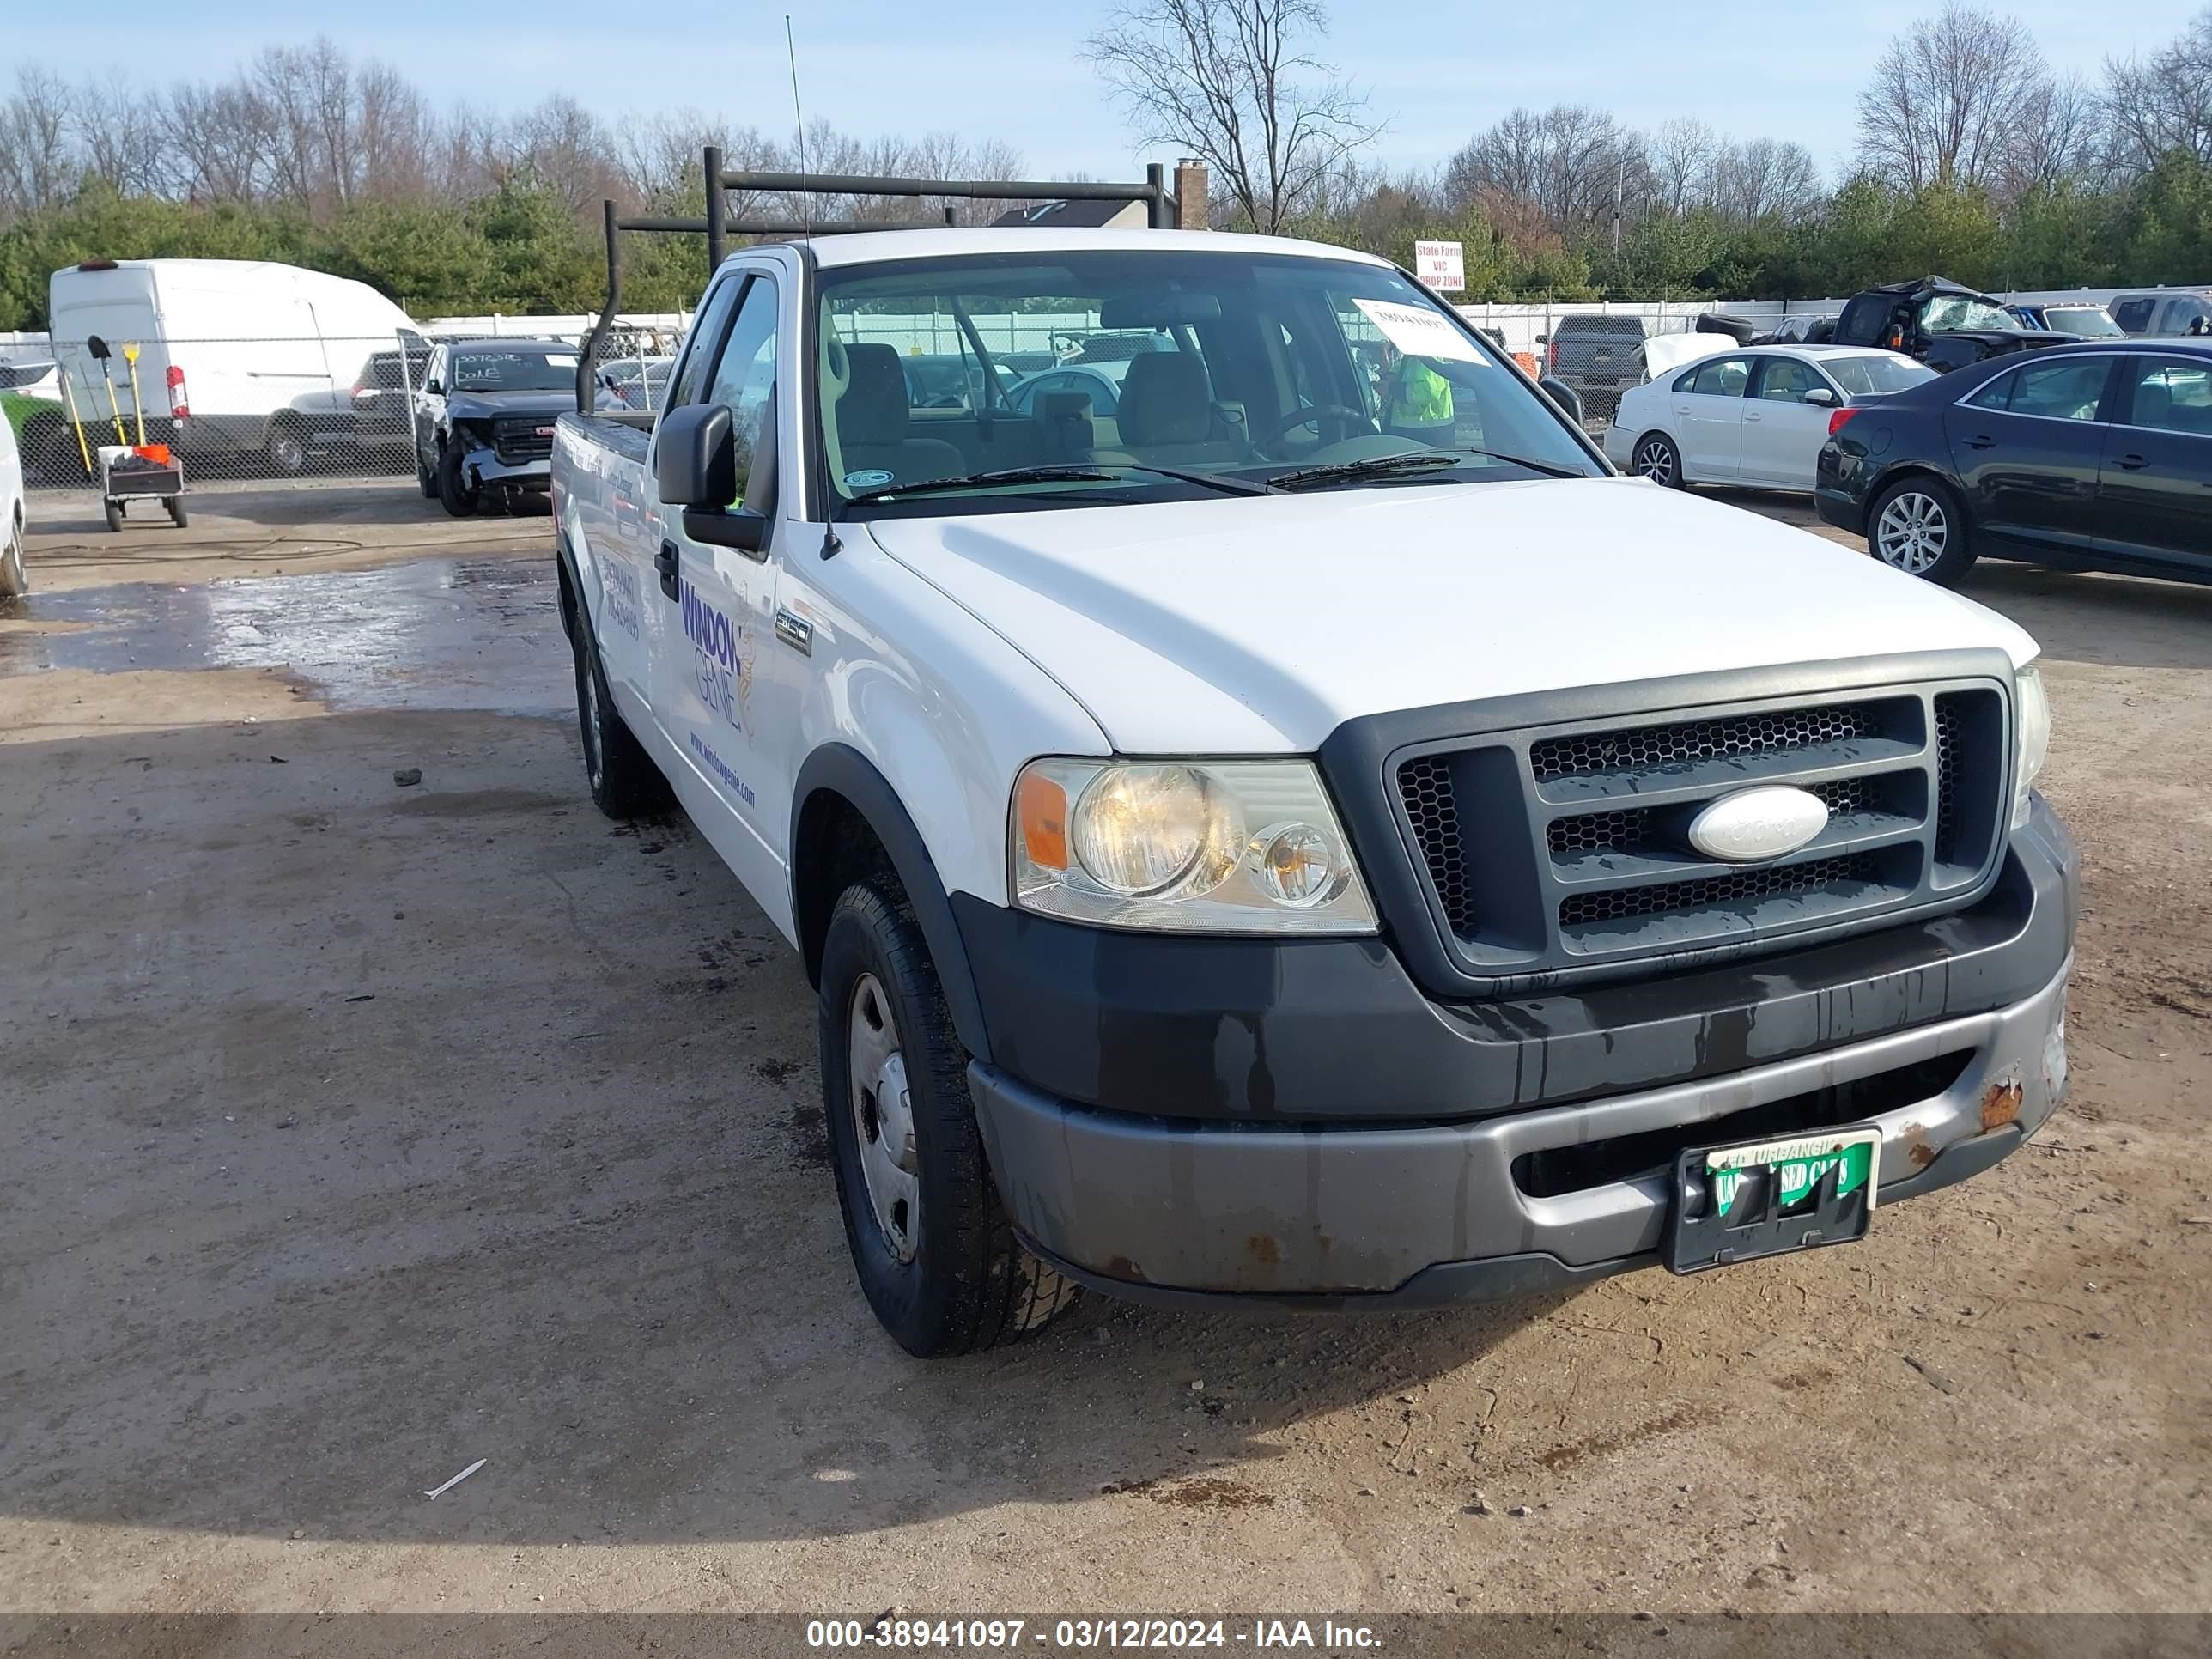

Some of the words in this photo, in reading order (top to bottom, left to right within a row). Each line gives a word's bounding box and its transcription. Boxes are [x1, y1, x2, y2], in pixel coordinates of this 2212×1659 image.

[1417, 245, 1439, 256] State
[1441, 246, 1462, 257] Farm
[1433, 260, 1448, 271] VIC
[1443, 276, 1462, 287] ZONE
[680, 577, 741, 677] WINDOW
[690, 731, 755, 811] www.windowgenie.com
